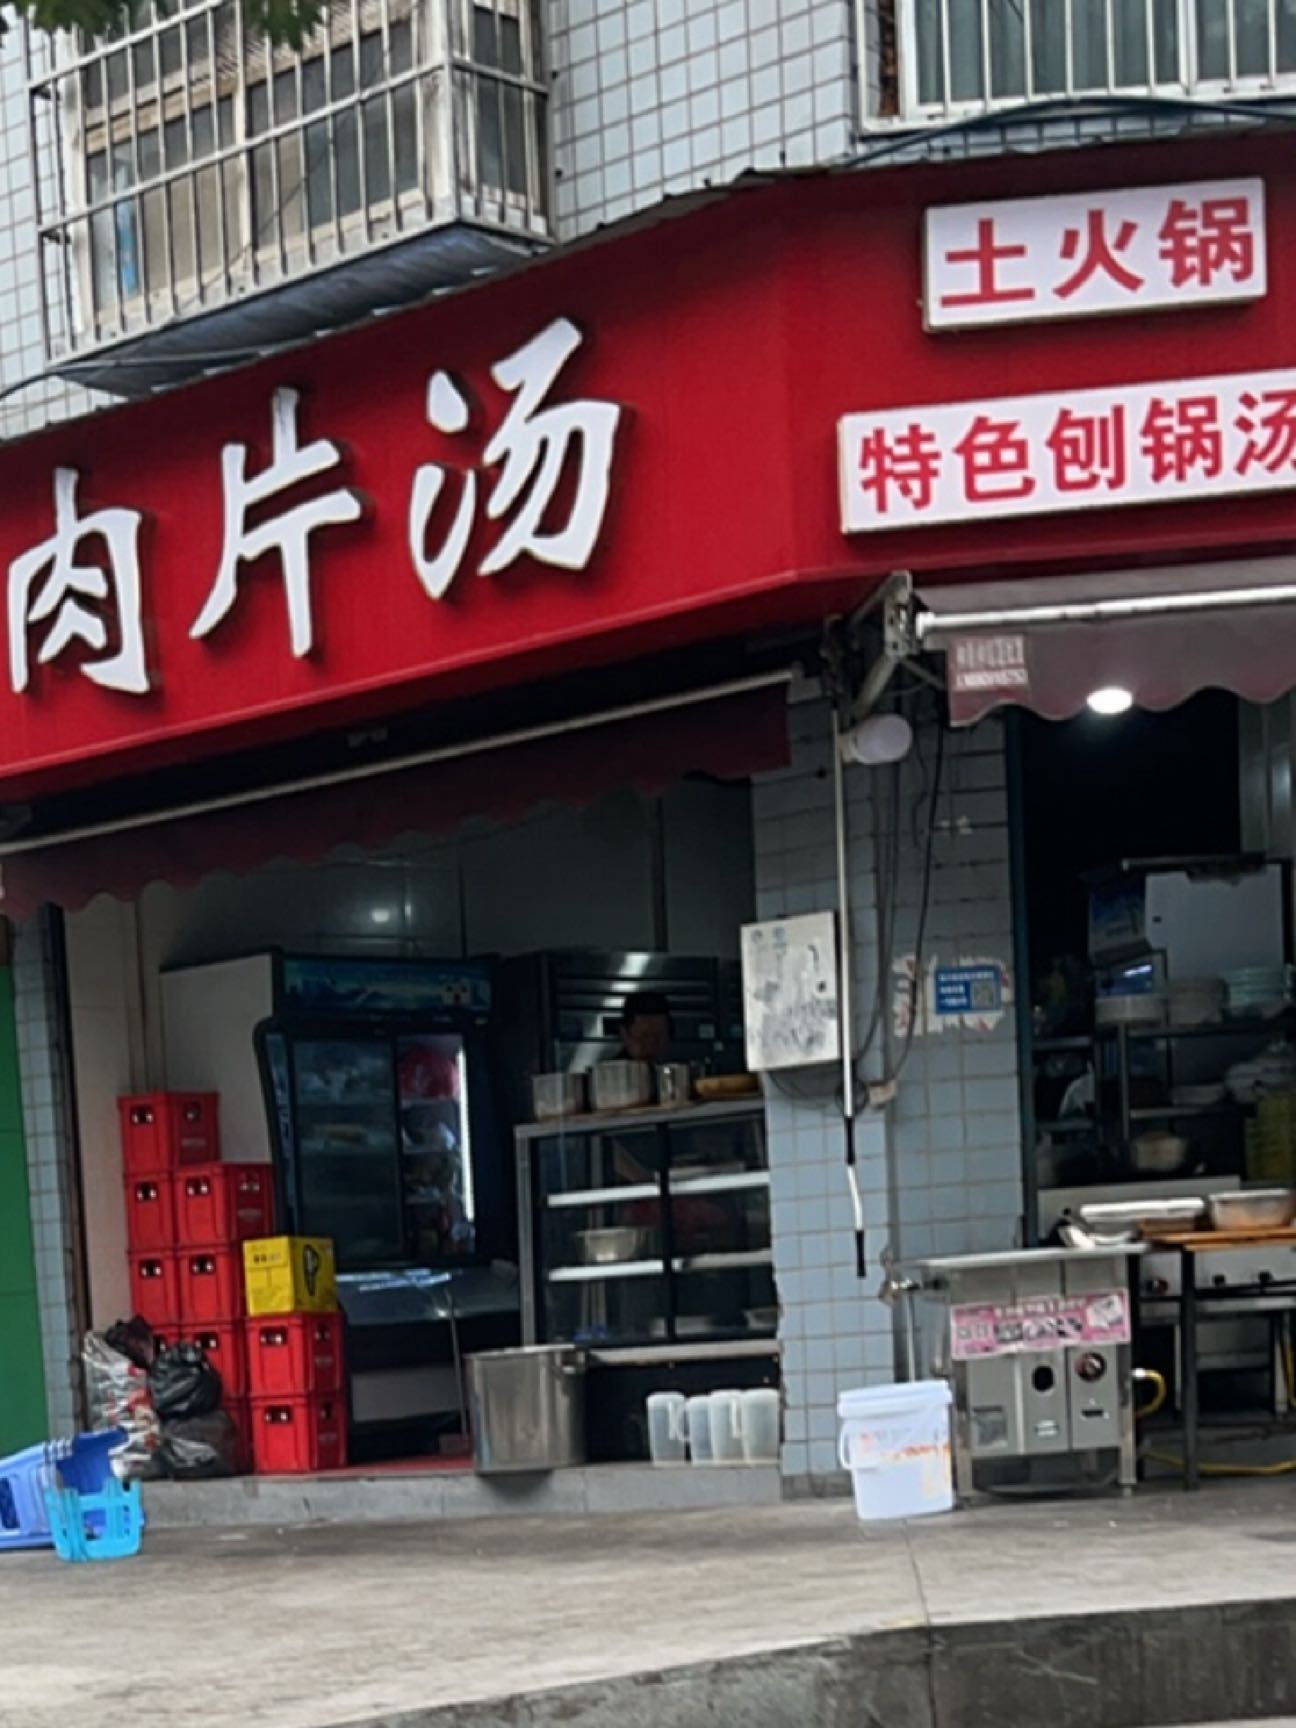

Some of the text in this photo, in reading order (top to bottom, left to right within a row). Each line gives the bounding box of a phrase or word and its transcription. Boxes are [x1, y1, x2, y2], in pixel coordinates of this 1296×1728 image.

[940, 196, 1254, 309] 土火锅
[7, 316, 621, 694] 肉片汤
[859, 389, 1296, 514] 特色刨锅汤
